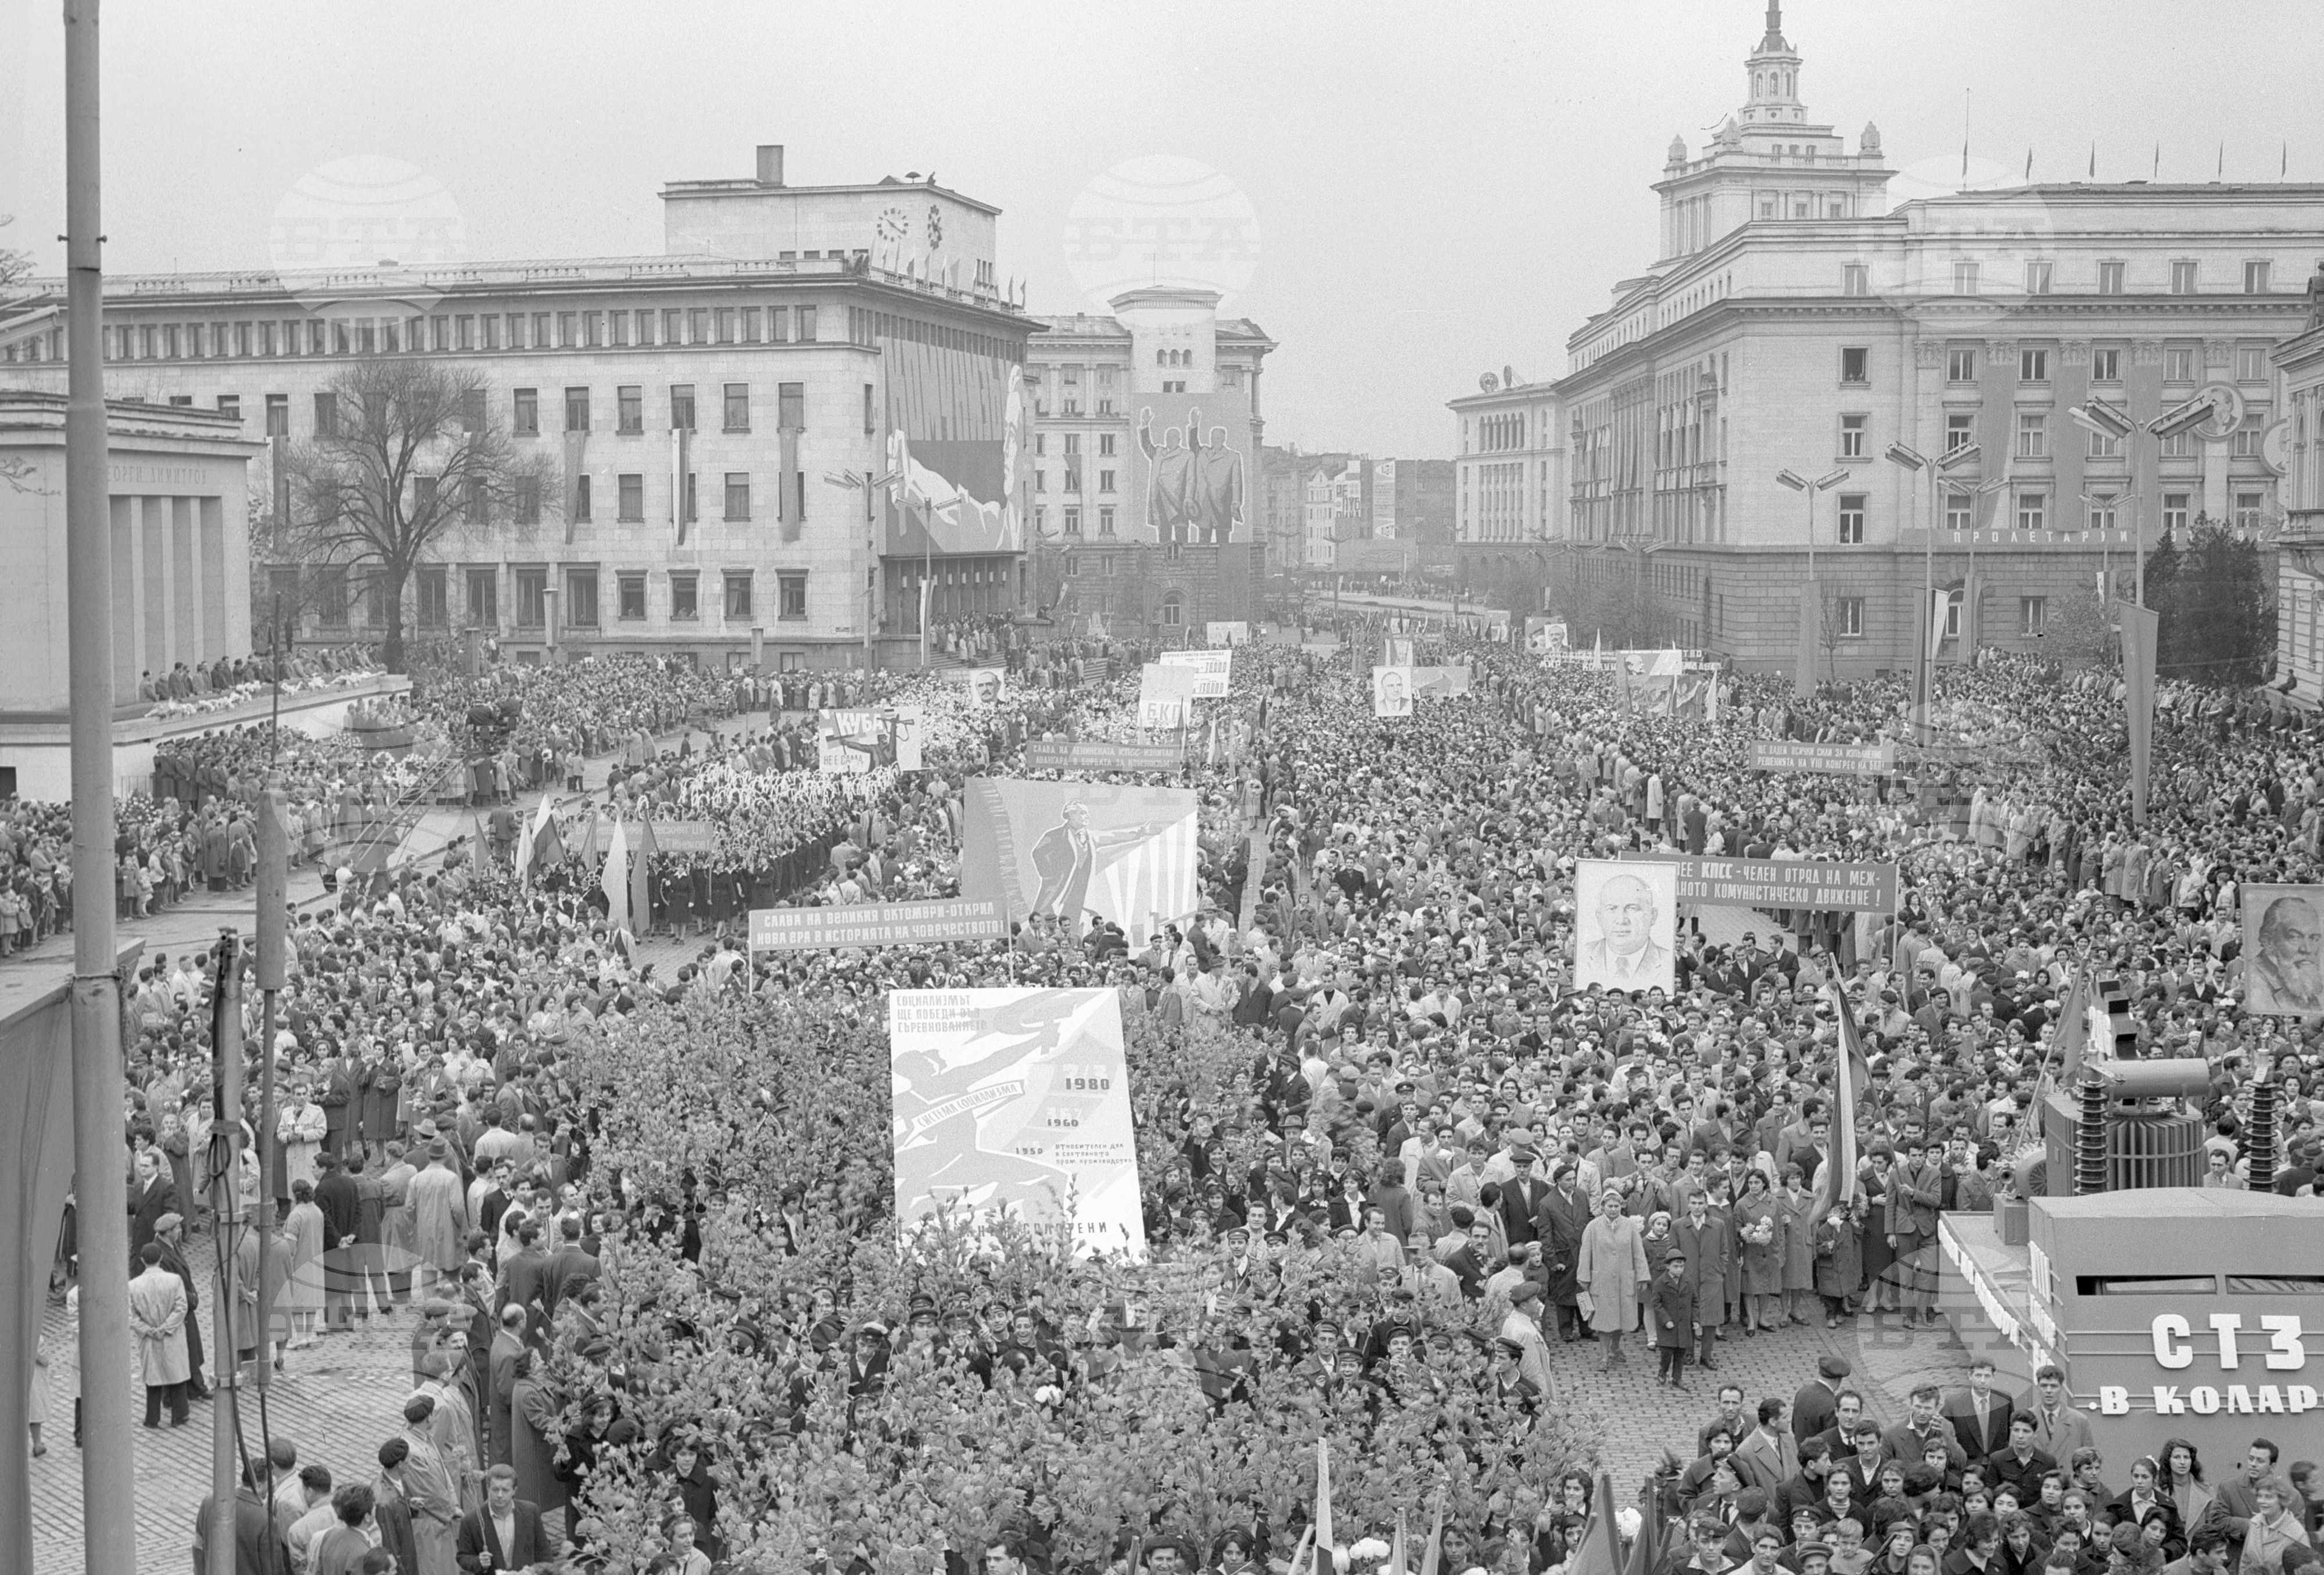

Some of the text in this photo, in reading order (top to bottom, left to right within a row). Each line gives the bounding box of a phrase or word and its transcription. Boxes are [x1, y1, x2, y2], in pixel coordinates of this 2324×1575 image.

[107, 465, 206, 484] ЕОРГИ ДИМИТРОВ
[835, 713, 884, 736] КУБА
[1034, 745, 1055, 754] СЛАВА
[1059, 745, 1068, 754] НА
[1073, 747, 1115, 756] ЛЕНИНСКАТА
[1758, 745, 1767, 754] ЩЕ
[1769, 745, 1787, 755] ДАДЕМ
[1791, 746, 1814, 756] ВСИЧКИ
[1817, 748, 1832, 756] СИЛИ
[1835, 748, 1843, 757] ЗА
[1036, 756, 1068, 766] АВАНГАРД
[1081, 758, 1112, 766] БОРБАТА
[1758, 756, 1795, 767] РЕШЕНИЯТА
[1798, 758, 1807, 767] НА
[1826, 759, 1856, 769] КОНГРЕС
[1857, 761, 1867, 770] НА
[1785, 867, 1820, 884] ОТРЯД
[1826, 869, 1841, 885] НА
[1850, 870, 1880, 887] МЕЖ-
[1715, 882, 1809, 903] КОМУНИСТИЧЕСКО
[764, 914, 801, 927] СЛАВА
[806, 913, 821, 925] НА
[827, 910, 878, 924] ВЕЛИКИЯ
[757, 920, 1003, 945] НОВА ЕРА В ИСТОРИЯТА НА ЧОВЕЧЕСТВОТО!
[896, 995, 970, 1007] СОЦИАЛИЗМЪТ
[898, 1009, 912, 1021] ЩЕ
[916, 1009, 956, 1021] ПОБЕДИ
[1066, 1078, 1109, 1090] 1980
[917, 1084, 1018, 1127] СИСТЕМА СОЦИАЛИЗМА
[1048, 1119, 1079, 1127] 1960
[1016, 1147, 1043, 1155] 1950
[2153, 1384, 2324, 1414] КОЛАР
